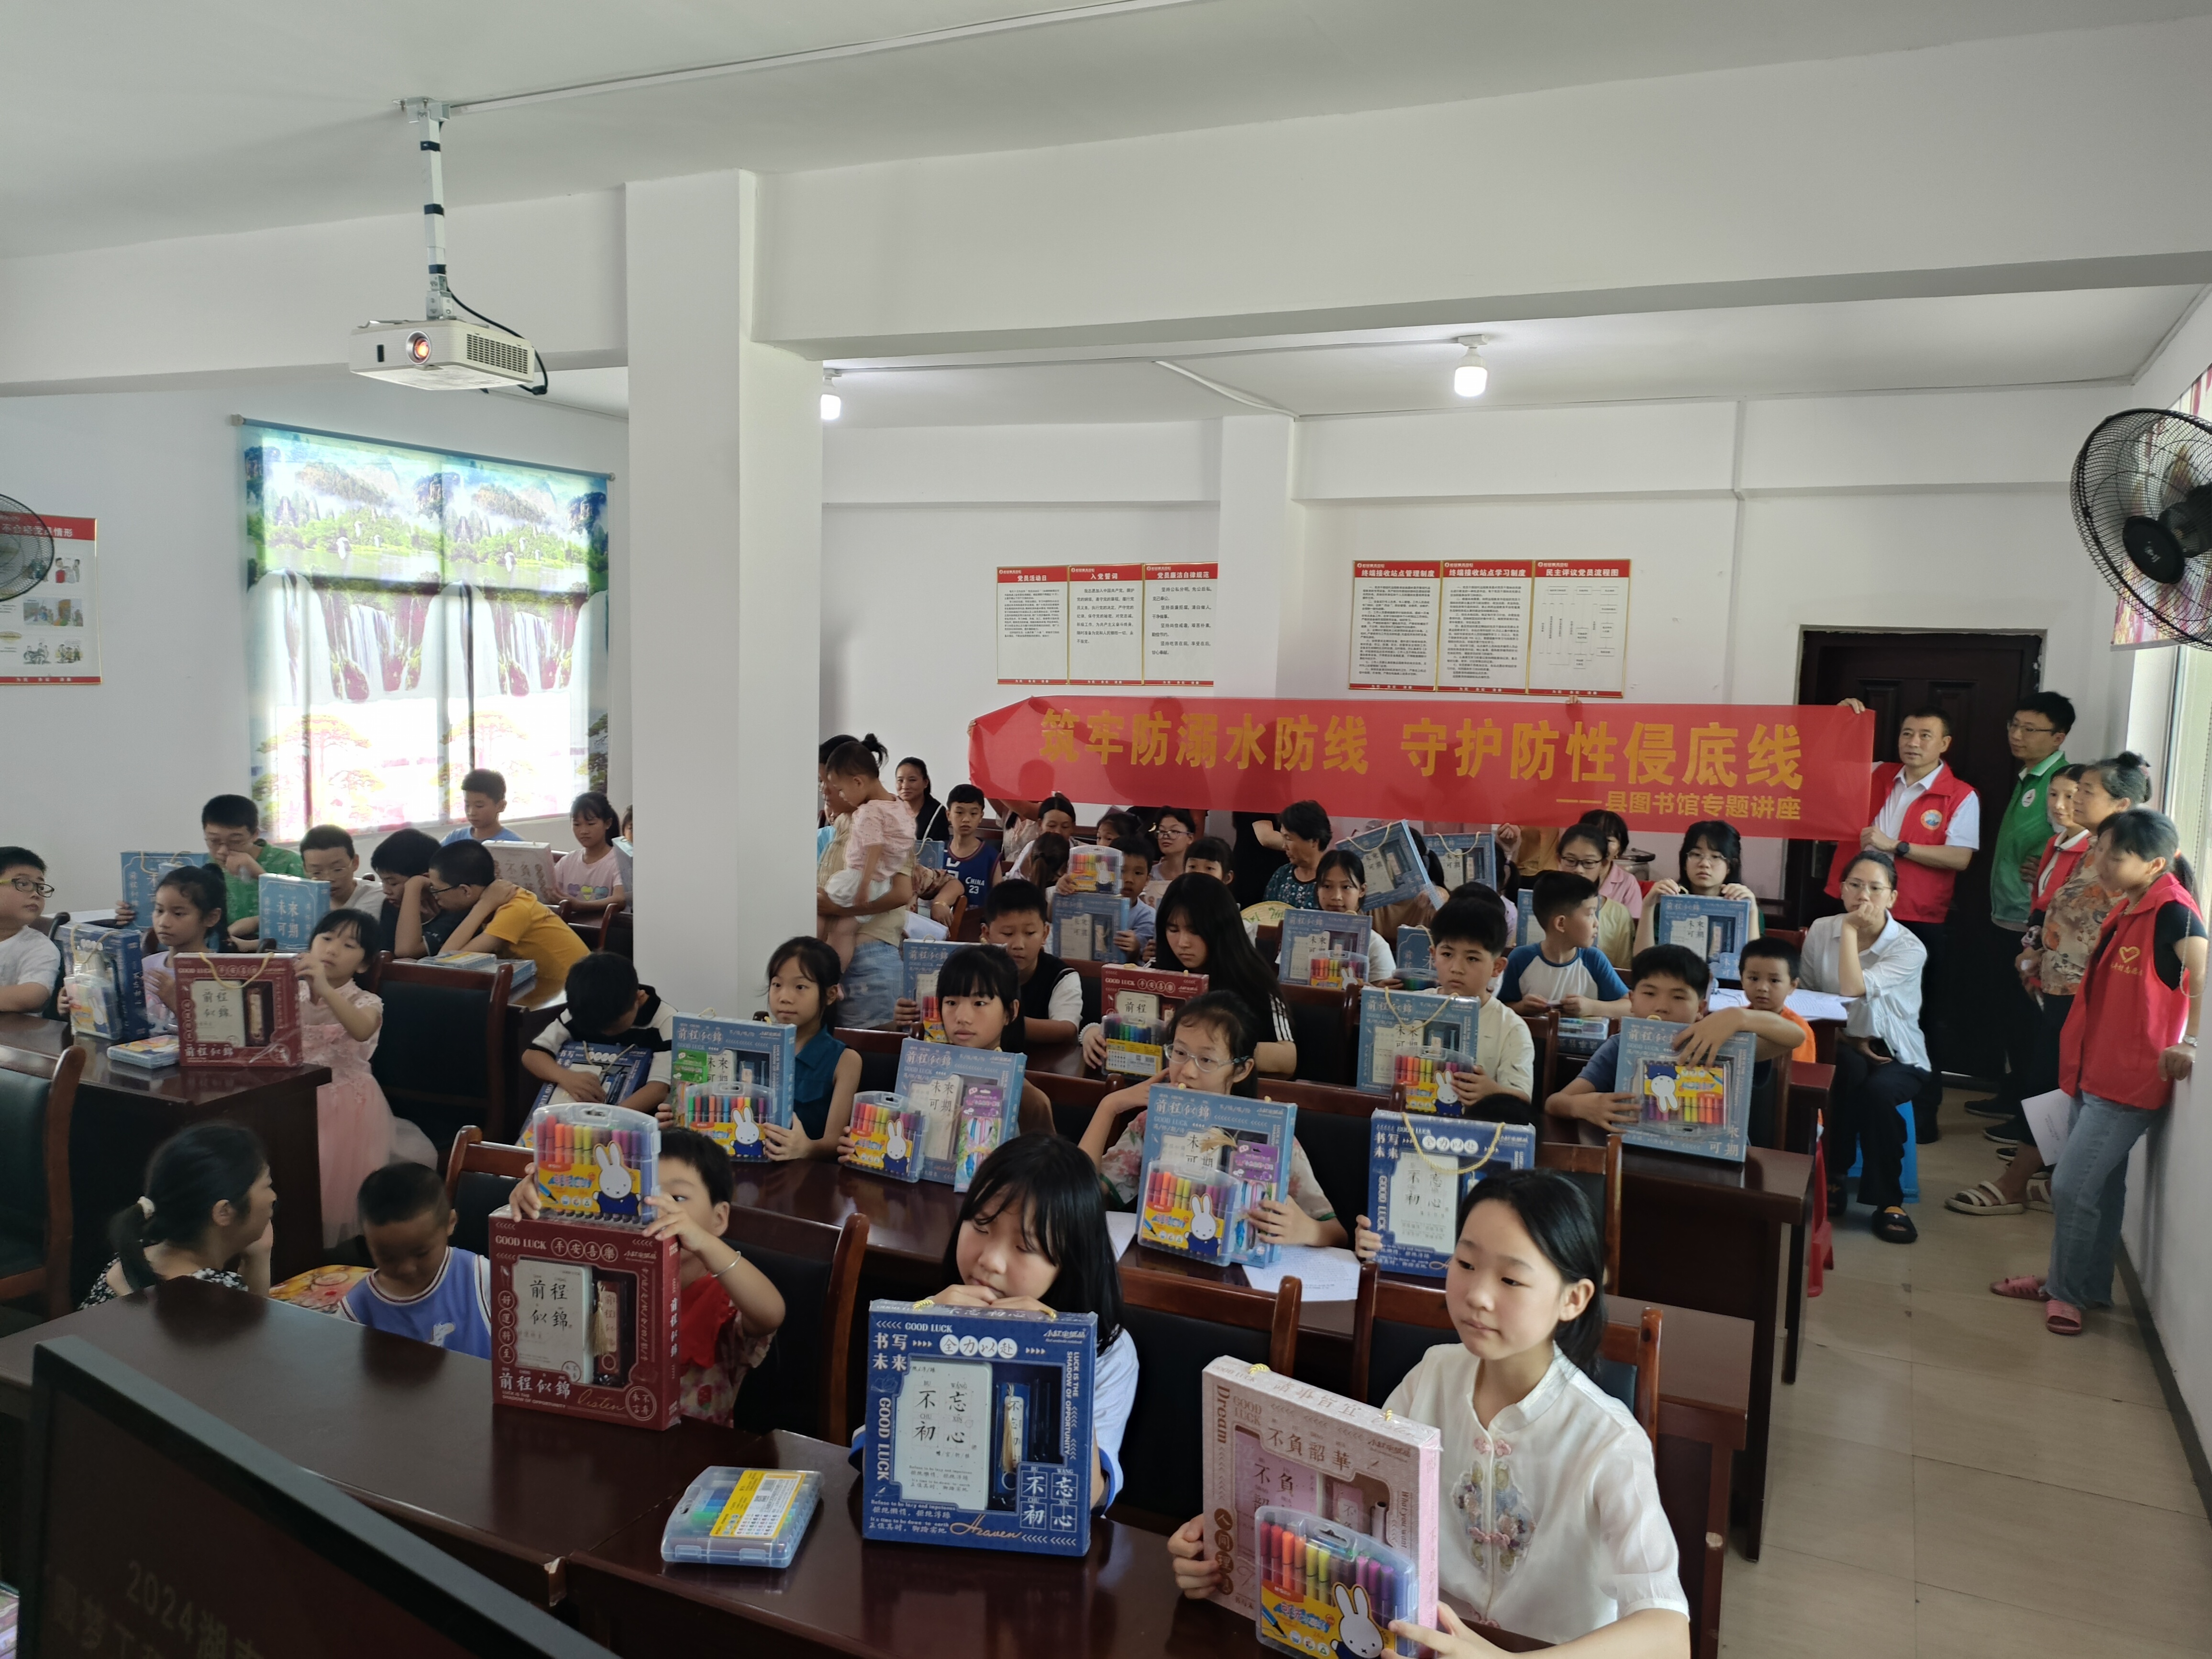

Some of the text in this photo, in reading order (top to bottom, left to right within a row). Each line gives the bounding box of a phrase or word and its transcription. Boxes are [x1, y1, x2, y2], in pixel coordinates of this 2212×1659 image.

[1039, 708, 1803, 790] 筑牢防溺水防线 守护防性侵底线
[965, 876, 984, 885] CHINA
[969, 885, 979, 894] 23
[276, 899, 299, 917] 未來
[277, 922, 298, 938] 可期
[202, 990, 229, 1002] 前程
[1125, 1002, 1147, 1013] 前程
[677, 1027, 722, 1042] 前程似錦
[185, 1046, 233, 1056] 前程似錦
[906, 1051, 951, 1068] 前程似錦
[708, 1056, 729, 1070] 未來
[931, 1081, 956, 1094] 未來
[929, 1099, 952, 1112] 可期
[1155, 1100, 1210, 1121] 前程似錦
[1154, 1116, 1188, 1127] GOOD LUCK
[1374, 1132, 1399, 1147] 书写
[1424, 1137, 1477, 1152] 全力以赴
[1374, 1146, 1399, 1160] 未来
[1709, 1140, 1739, 1157] 可期
[1186, 1154, 1213, 1168] 可期
[1408, 1169, 1442, 1188] 不忘
[1377, 1175, 1387, 1230] GOOD LUCK
[1405, 1191, 1440, 1208] 初心
[496, 1235, 547, 1250] GOOD LUCK
[554, 1240, 616, 1259] 平安喜樂
[530, 1280, 567, 1300] 前程
[531, 1310, 568, 1331] 似錦
[905, 1322, 952, 1332] GOOD LUCK
[873, 1332, 908, 1351] 书写
[943, 1338, 1013, 1355] 全力以赴
[873, 1353, 907, 1371] 未来
[499, 1372, 571, 1399] 前程似錦
[1073, 1373, 1079, 1382] IS
[915, 1390, 966, 1412] 不忘
[1066, 1389, 1072, 1399] OF
[532, 1400, 566, 1408] OPPORTUNITY
[1233, 1395, 1262, 1415] GOOD
[1217, 1385, 1230, 1444] Dream
[1234, 1407, 1261, 1426] LUCK
[913, 1421, 965, 1443] 初心
[1064, 1401, 1072, 1455] OPPORTUNITY
[877, 1397, 891, 1481] GOOD LUCK
[1267, 1427, 1351, 1471] 不負韶華
[1023, 1476, 1073, 1497] 不忘
[1254, 1462, 1294, 1496] 不負
[1022, 1505, 1073, 1527] 初心
[1399, 1511, 1407, 1527] you
